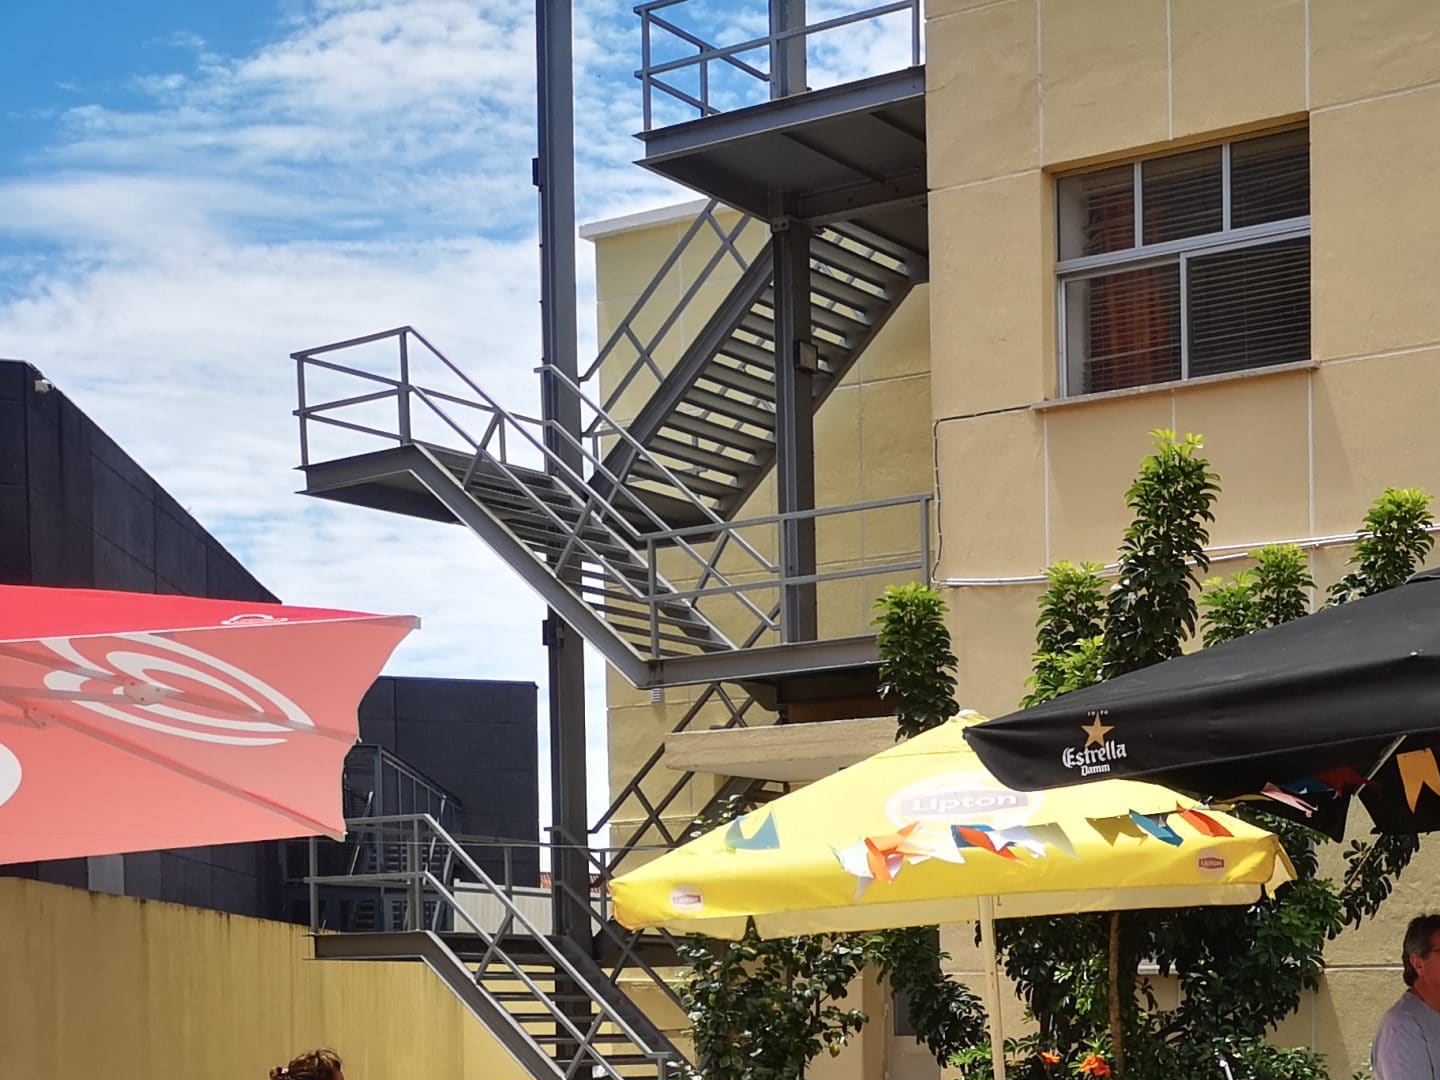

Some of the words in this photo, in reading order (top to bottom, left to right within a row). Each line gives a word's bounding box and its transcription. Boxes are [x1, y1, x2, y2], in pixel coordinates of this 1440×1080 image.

[1062, 740, 1127, 768] Estrella
[1080, 764, 1111, 776] Damm
[911, 794, 1017, 812] Lipton
